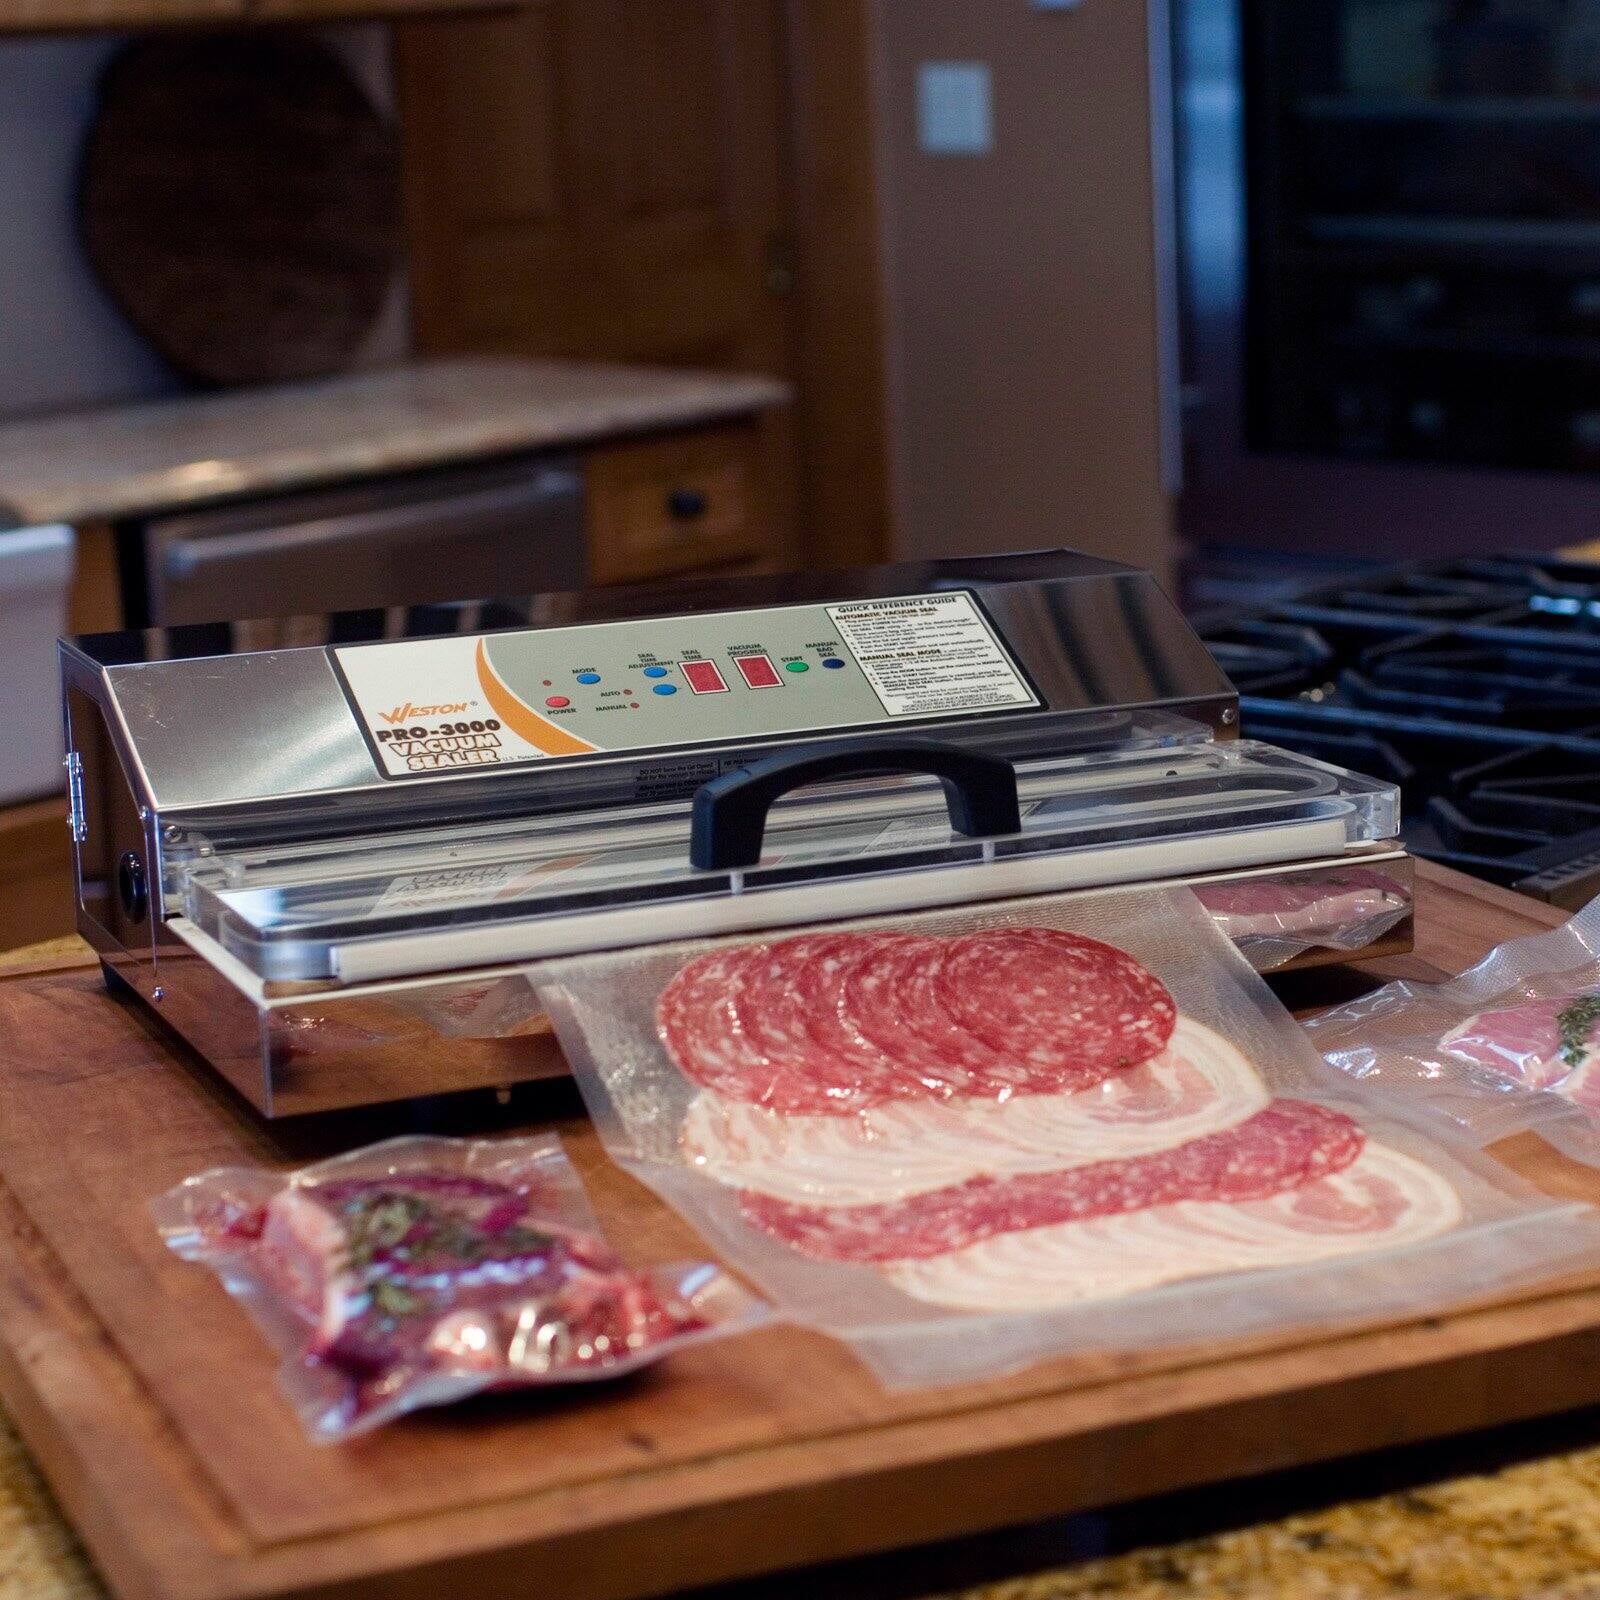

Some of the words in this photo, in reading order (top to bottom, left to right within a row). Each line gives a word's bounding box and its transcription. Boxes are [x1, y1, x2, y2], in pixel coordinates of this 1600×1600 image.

[838, 604, 870, 612] QUICK
[870, 600, 925, 609] REFERENCE
[925, 597, 957, 605] GUIDE
[835, 611, 881, 620] AUTOMATIC
[805, 640, 839, 648] MANUAL
[860, 653, 895, 661] MANUAL
[628, 660, 674, 670] ADJUSTMENT
[379, 702, 468, 725] WESTON
[596, 704, 628, 712] MANUAL
[376, 718, 501, 743] PRO-3000
[389, 732, 502, 757] VACUUM
[406, 749, 501, 771] SEALER
